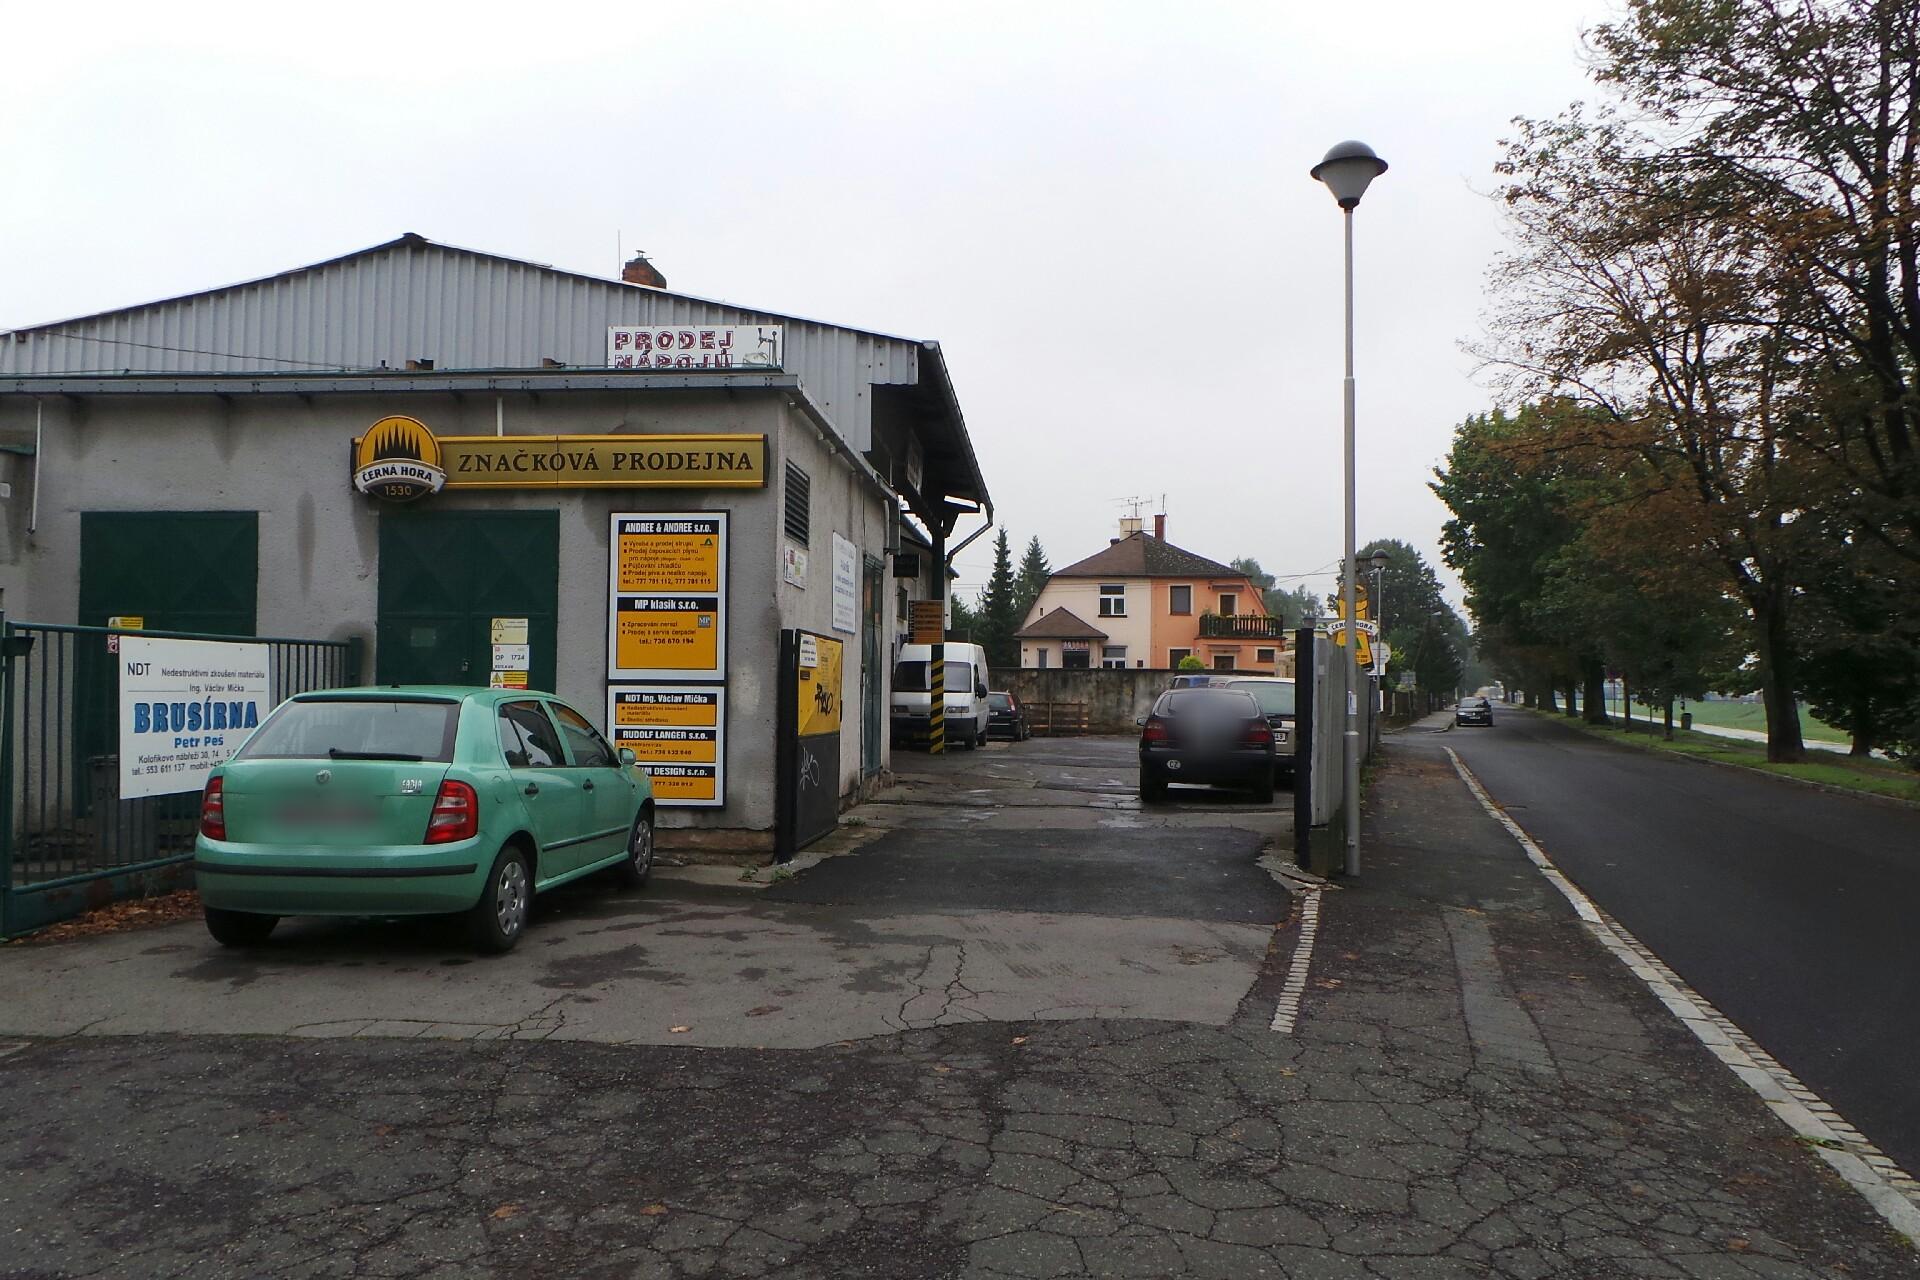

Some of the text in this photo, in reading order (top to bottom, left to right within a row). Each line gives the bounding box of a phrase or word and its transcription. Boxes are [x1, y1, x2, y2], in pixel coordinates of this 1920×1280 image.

[615, 331, 734, 350] PRODEJ
[458, 448, 753, 472] ZNAČKOVÁ PRODEJNA
[362, 464, 432, 482] ČERNÁ HORA
[384, 486, 412, 496] 1530
[625, 522, 712, 533] ANDREE & ANDREE s.r.o.
[634, 599, 699, 610] MP klasik s.r.o.
[127, 662, 151, 676] NDT
[189, 683, 202, 694] Ing.
[204, 683, 225, 692] Václav
[625, 694, 708, 704] NDT Ing. Václav Mička
[134, 696, 259, 734] BRUSÍRNA
[623, 730, 708, 740] RUDOLF LANGER s.r.o.
[174, 734, 224, 748] Petr Peš
[654, 767, 685, 776] DESIGN
